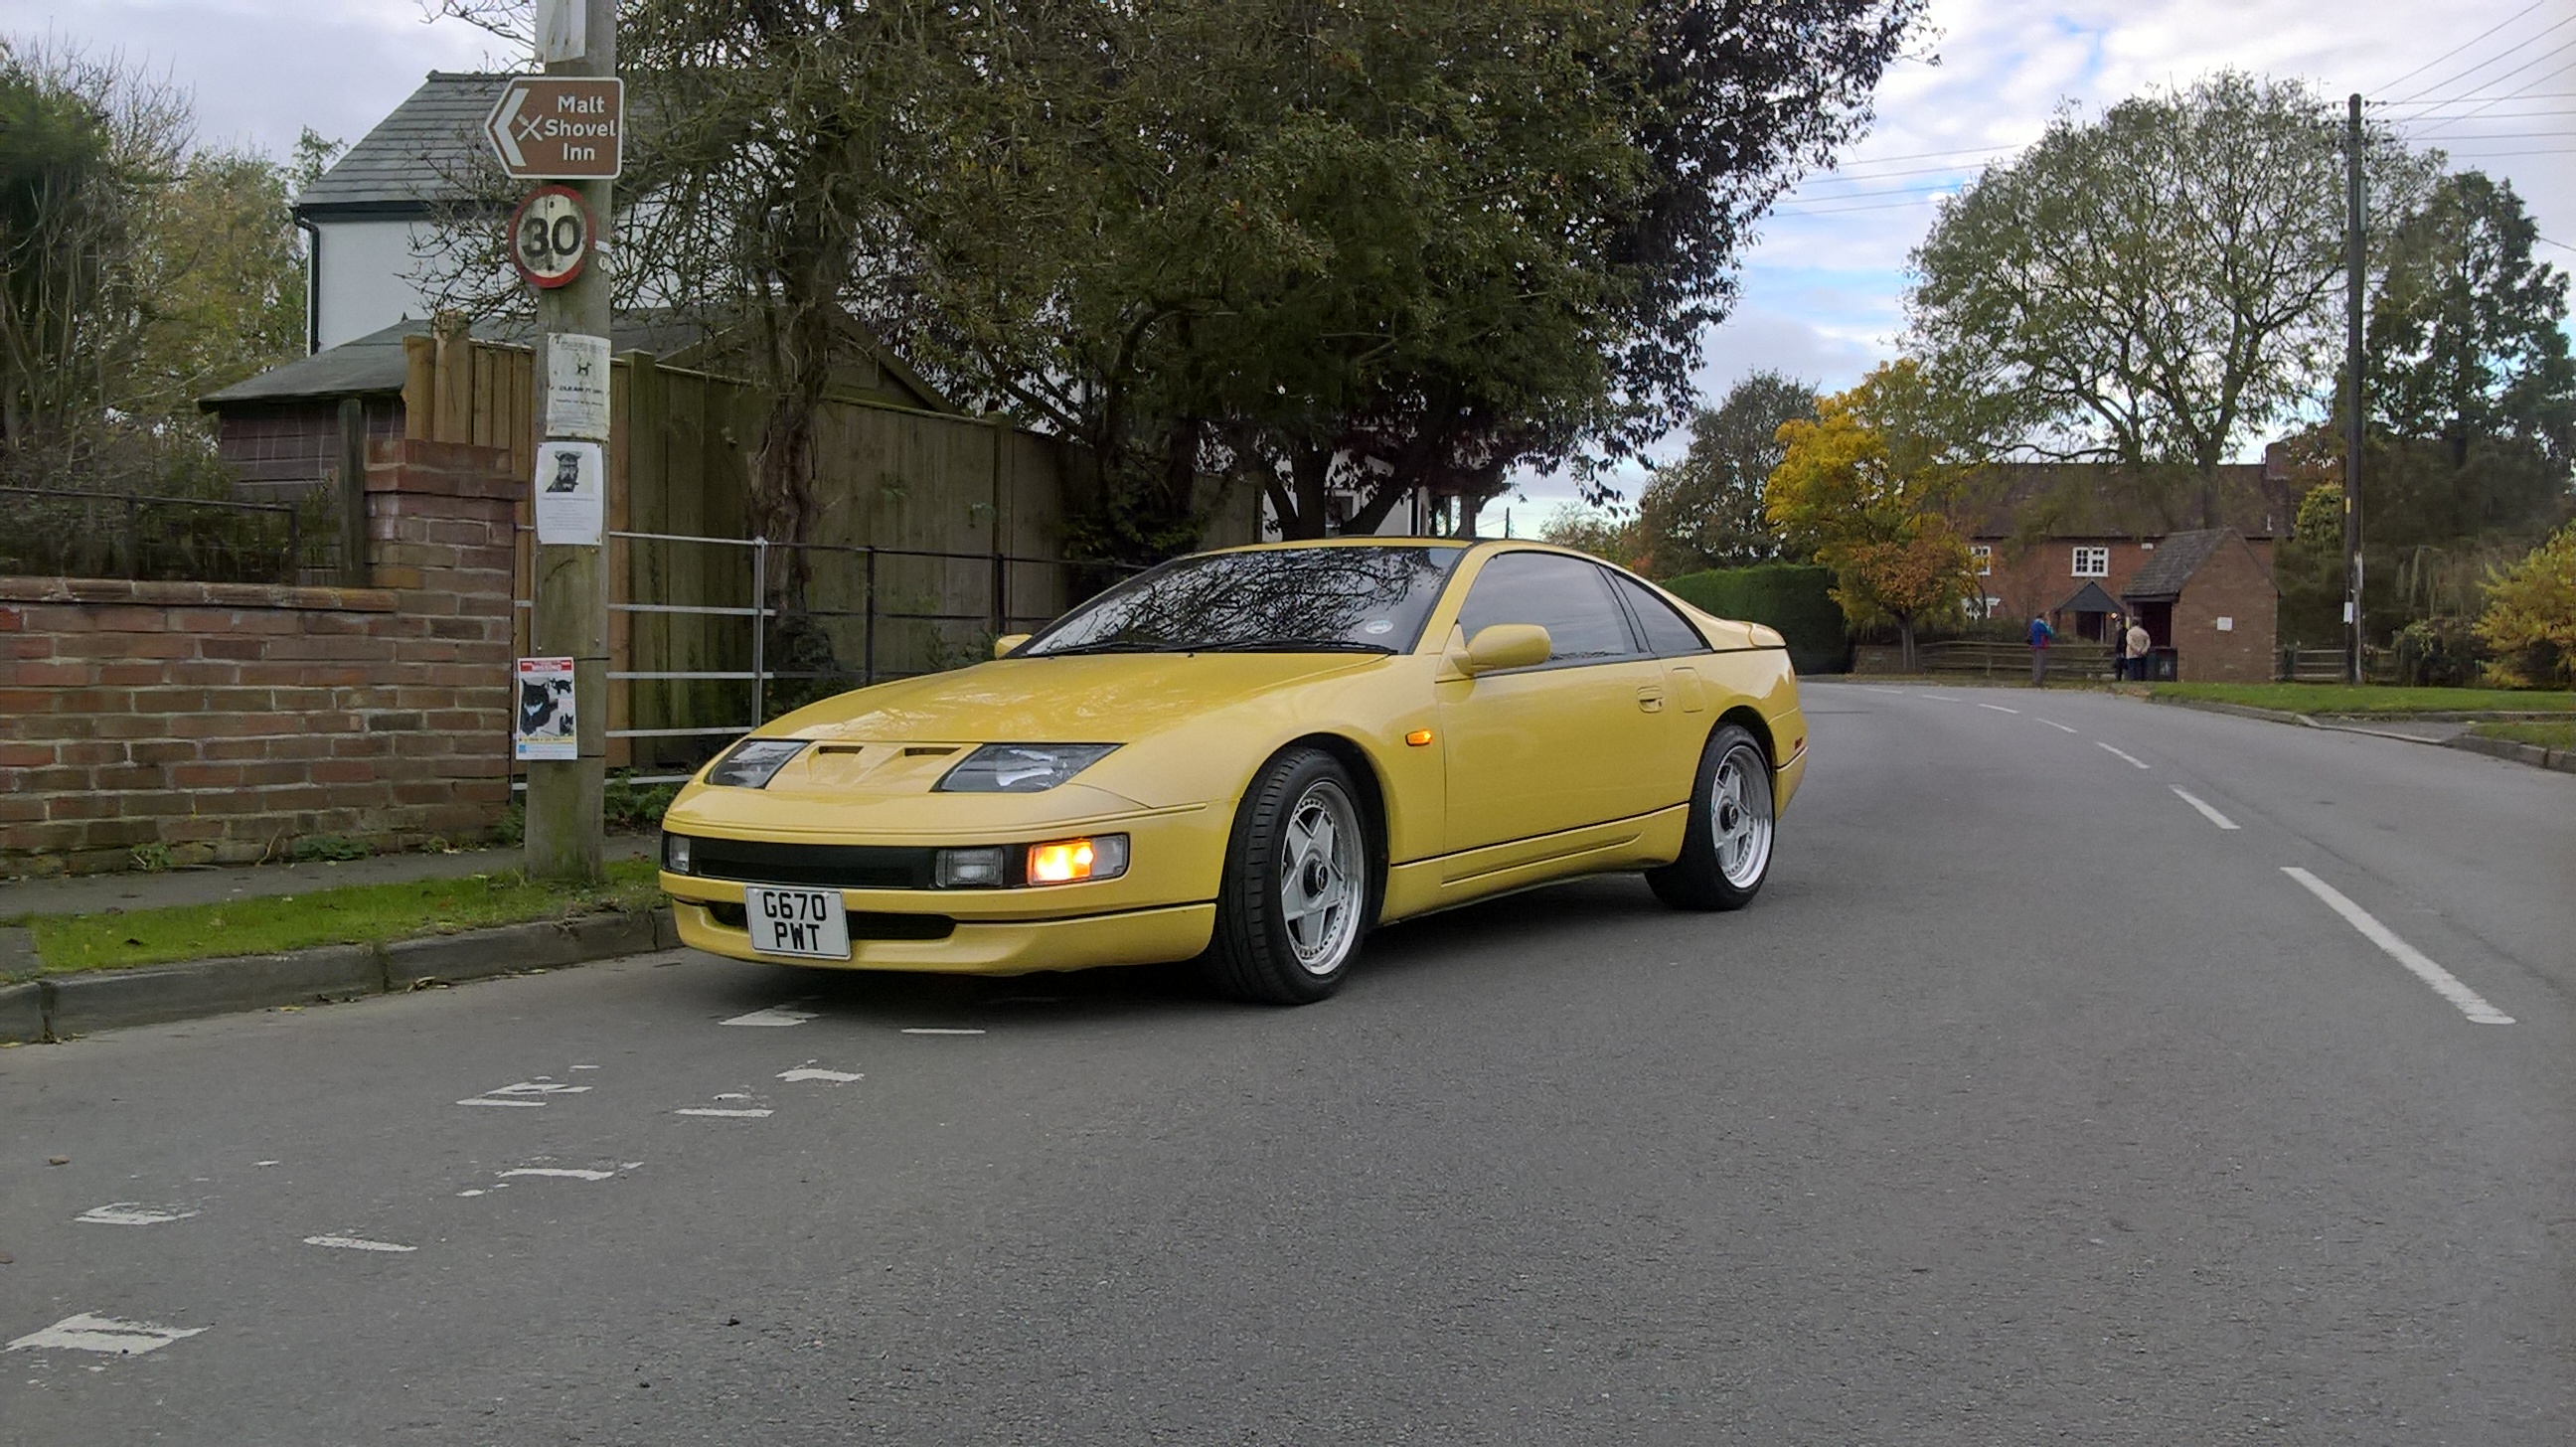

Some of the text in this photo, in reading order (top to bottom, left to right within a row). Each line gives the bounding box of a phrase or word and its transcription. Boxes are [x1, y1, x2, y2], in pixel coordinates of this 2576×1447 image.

[558, 95, 605, 114] Malt
[544, 118, 616, 137] Shovel
[563, 142, 595, 161] Inn
[522, 215, 581, 256] 30
[762, 890, 827, 921] G670
[773, 920, 820, 951] PWT
